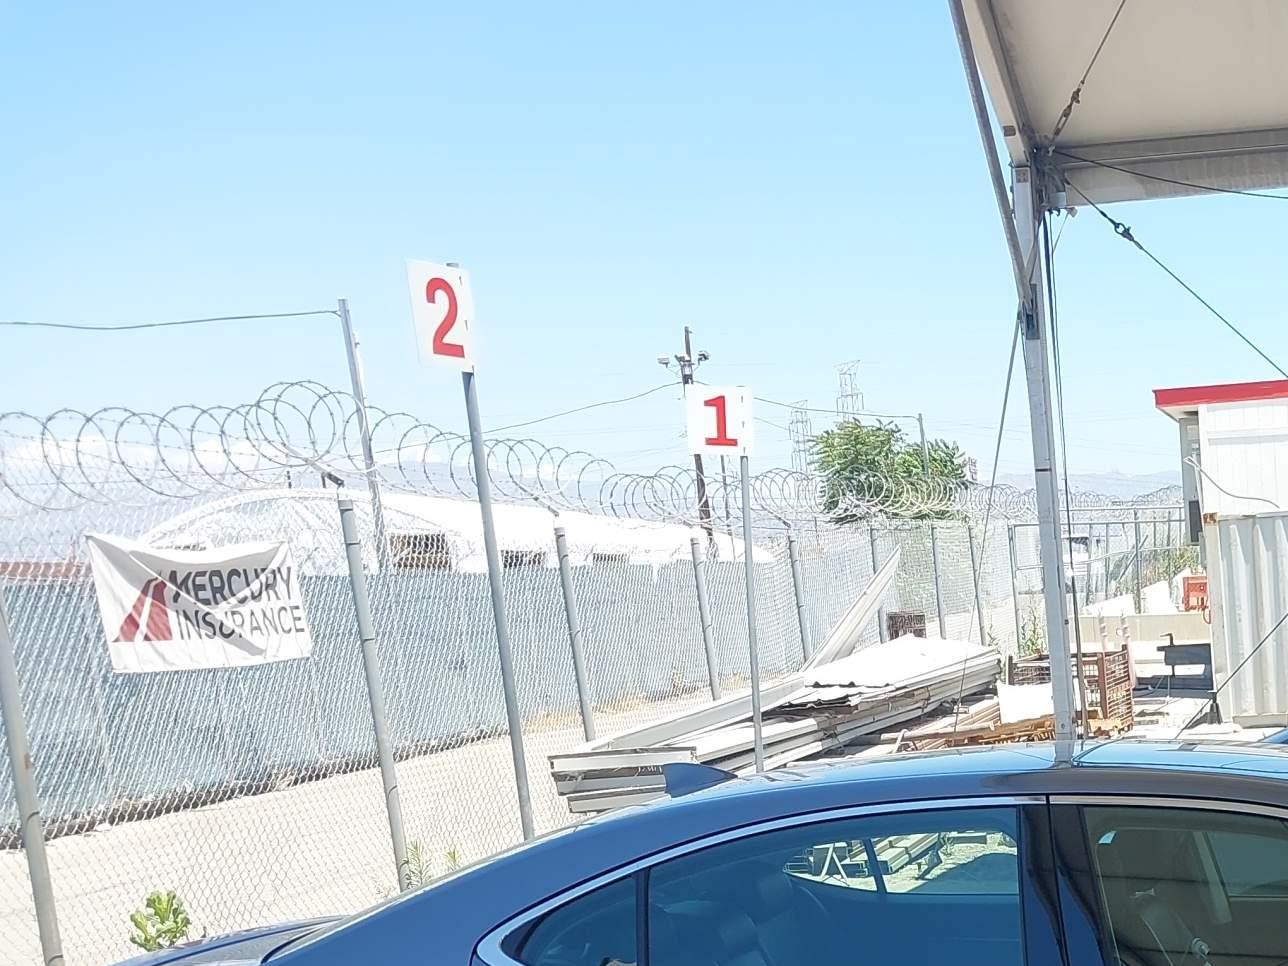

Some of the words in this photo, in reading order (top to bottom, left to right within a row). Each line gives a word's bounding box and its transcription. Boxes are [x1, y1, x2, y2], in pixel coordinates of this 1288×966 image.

[425, 276, 465, 358] 2
[703, 394, 738, 447] 1
[168, 566, 292, 606] MERCURY
[175, 605, 305, 641] INSURANCE
